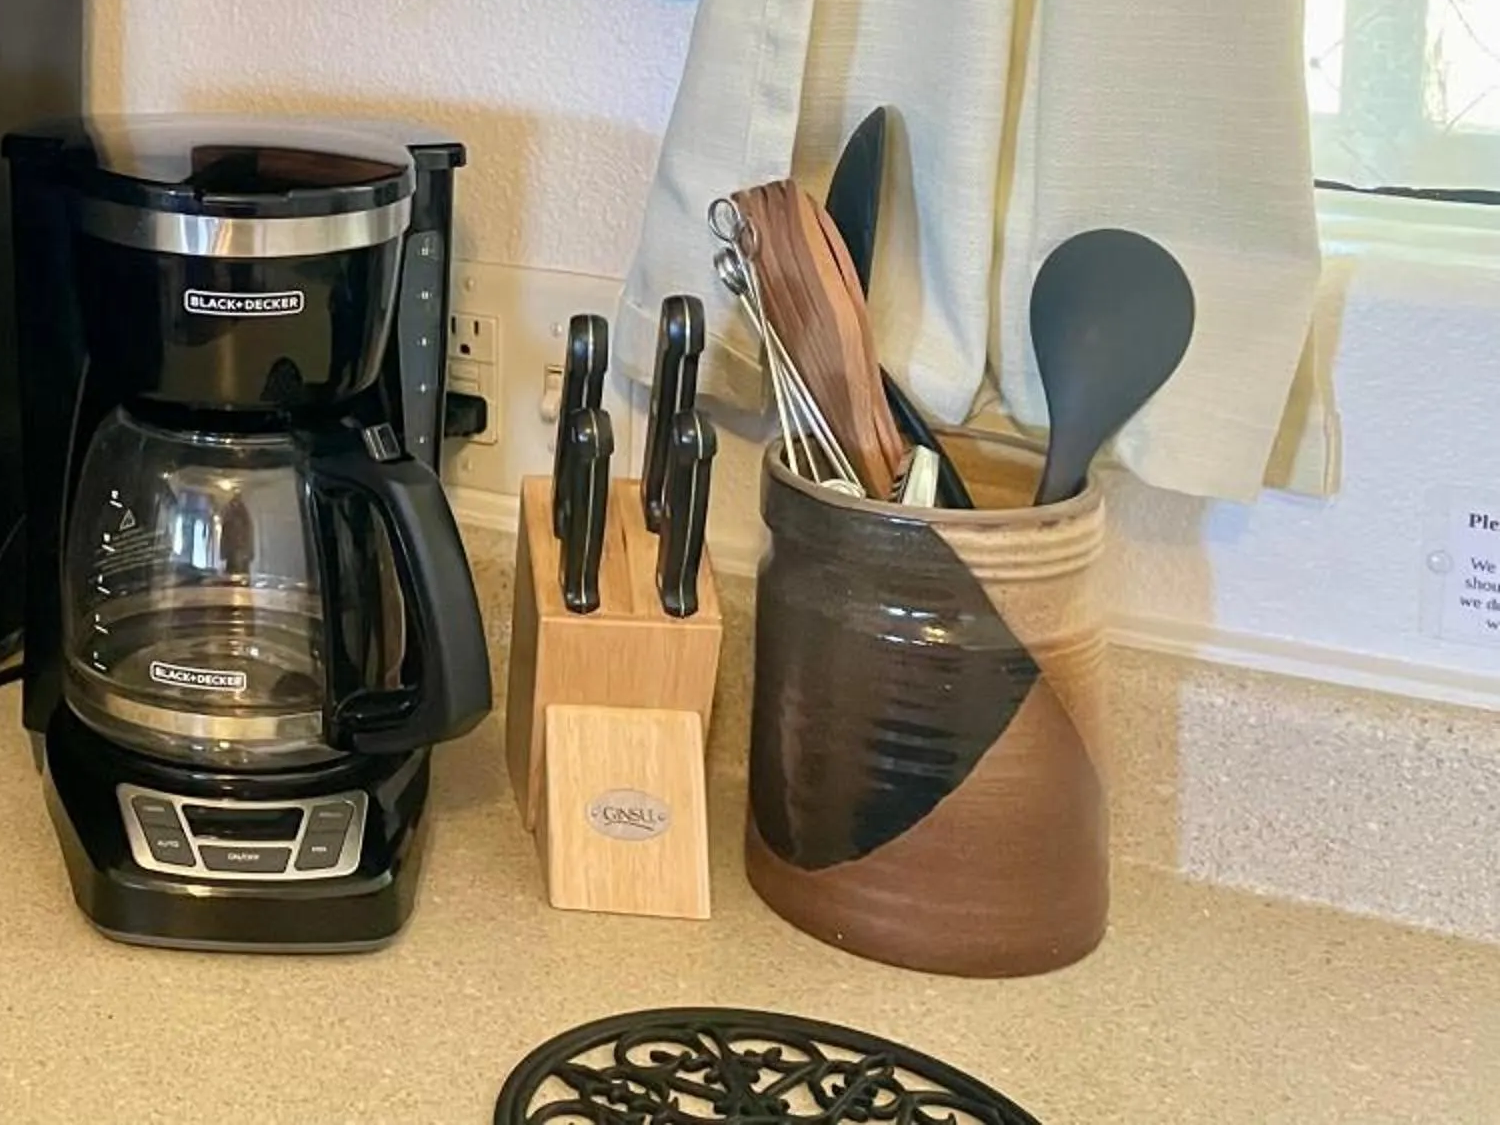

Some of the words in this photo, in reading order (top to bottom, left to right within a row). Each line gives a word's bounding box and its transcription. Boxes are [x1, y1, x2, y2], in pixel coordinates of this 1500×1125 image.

[190, 295, 299, 311] BLACK+DECKER
[1471, 556, 1497, 574] We
[1460, 596, 1482, 610] we
